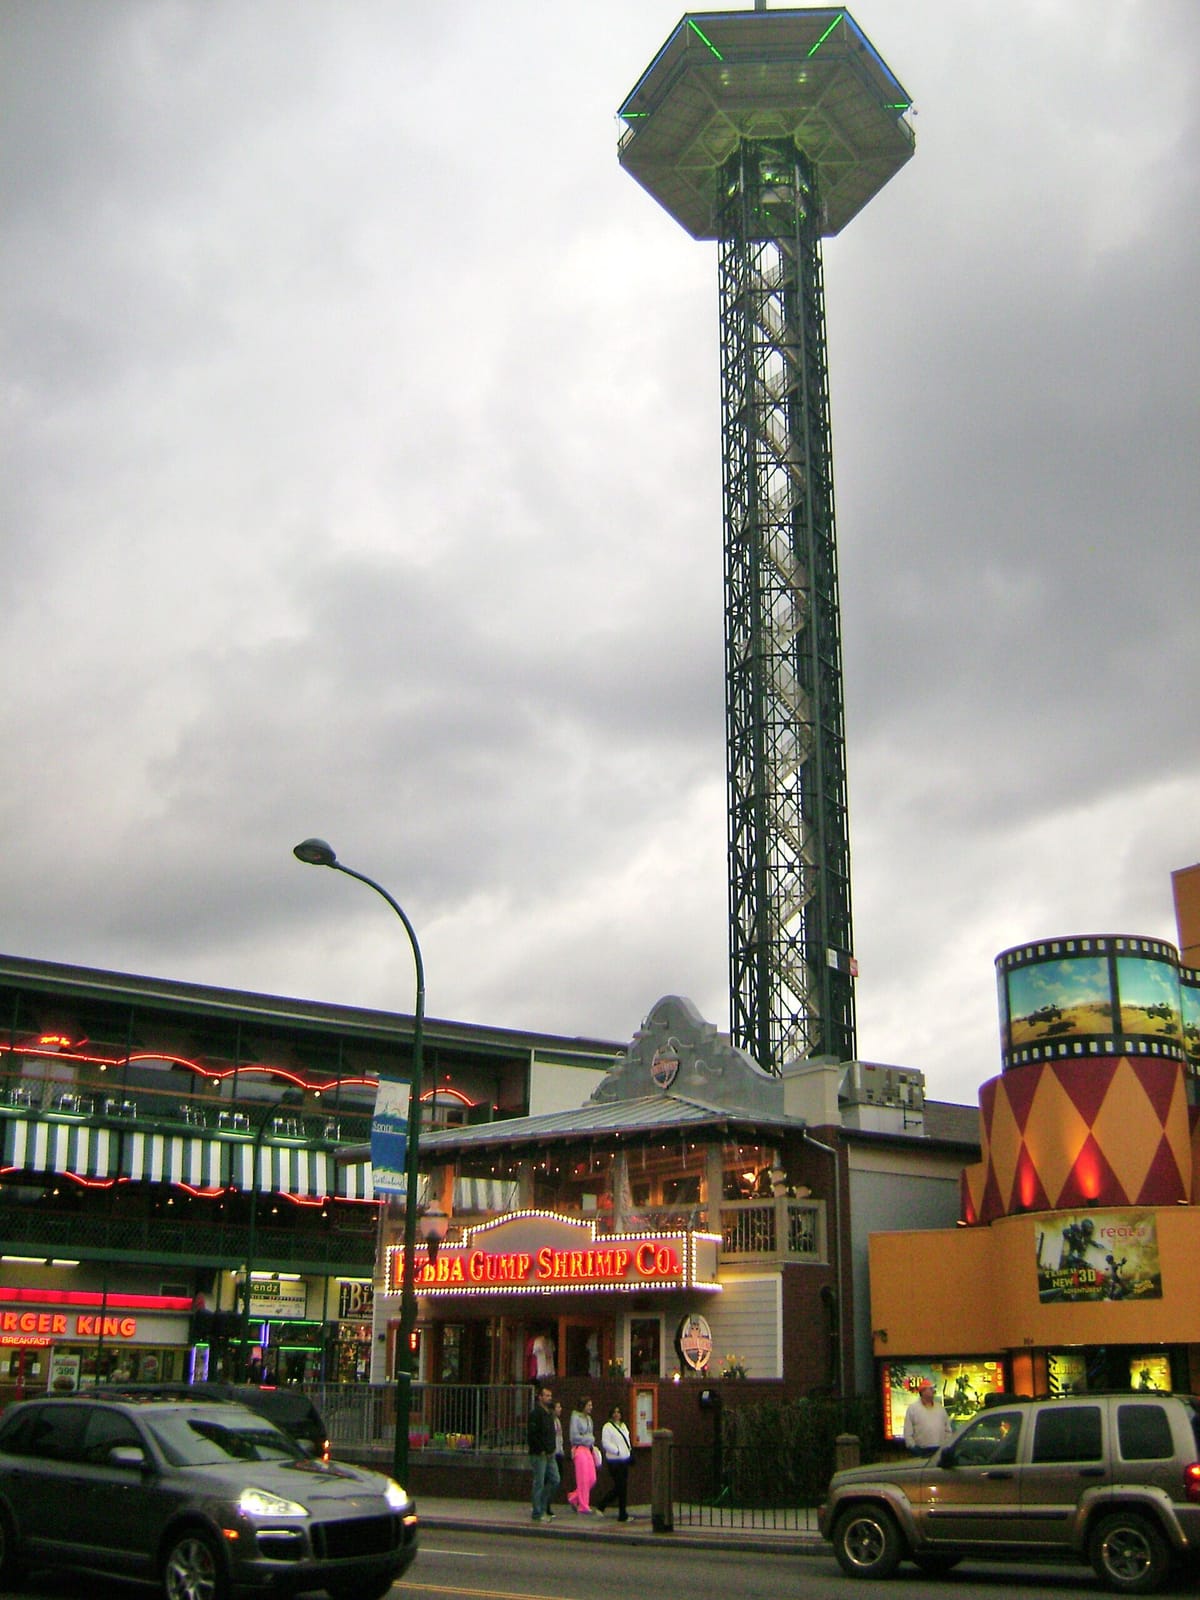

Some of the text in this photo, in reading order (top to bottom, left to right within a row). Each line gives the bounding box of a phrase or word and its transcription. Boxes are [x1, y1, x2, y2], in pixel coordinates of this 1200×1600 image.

[470, 1250, 529, 1280] GUMP
[538, 1248, 627, 1278] SHRIMP
[1052, 1277, 1073, 1288] NEW
[1078, 1269, 1097, 1283] 3D
[77, 1315, 137, 1337] KING
[2, 1336, 51, 1346] BREAKFAST
